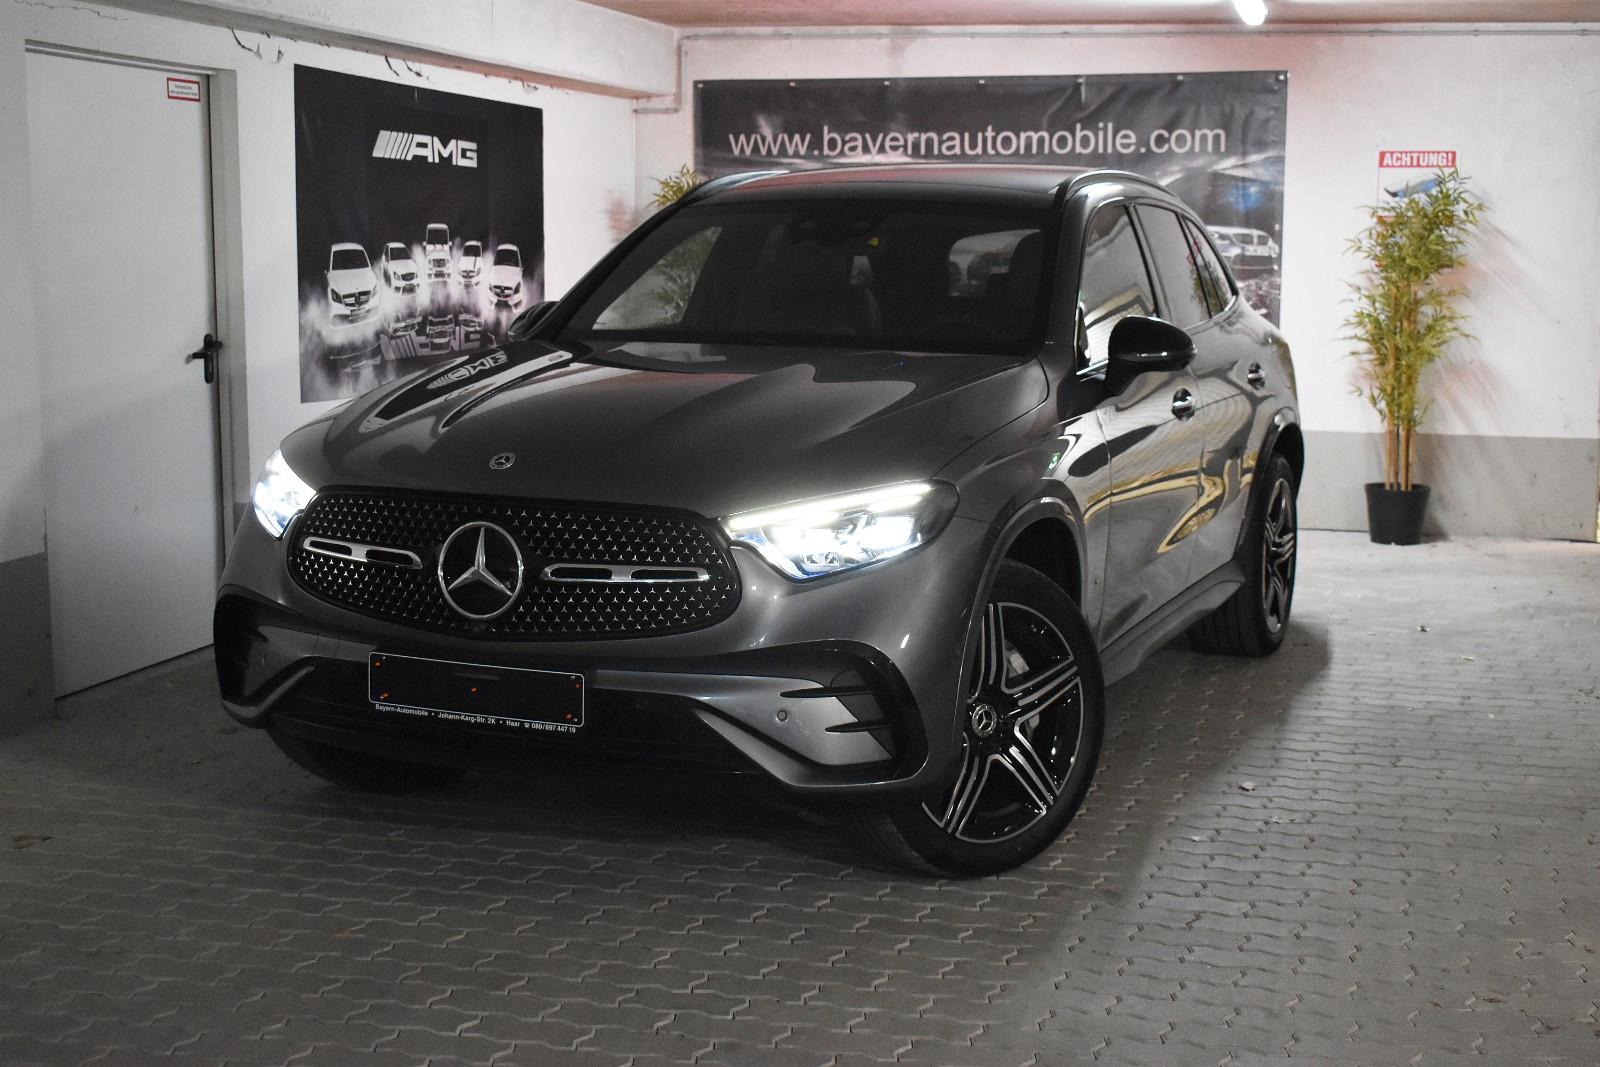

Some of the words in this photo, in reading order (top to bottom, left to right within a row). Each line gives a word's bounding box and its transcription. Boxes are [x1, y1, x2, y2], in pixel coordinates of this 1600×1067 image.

[405, 133, 478, 168] AMG
[1382, 151, 1453, 167] ACHTUNG!
[375, 703, 429, 717] Bayern-Automobile
[506, 719, 521, 727] Haar
